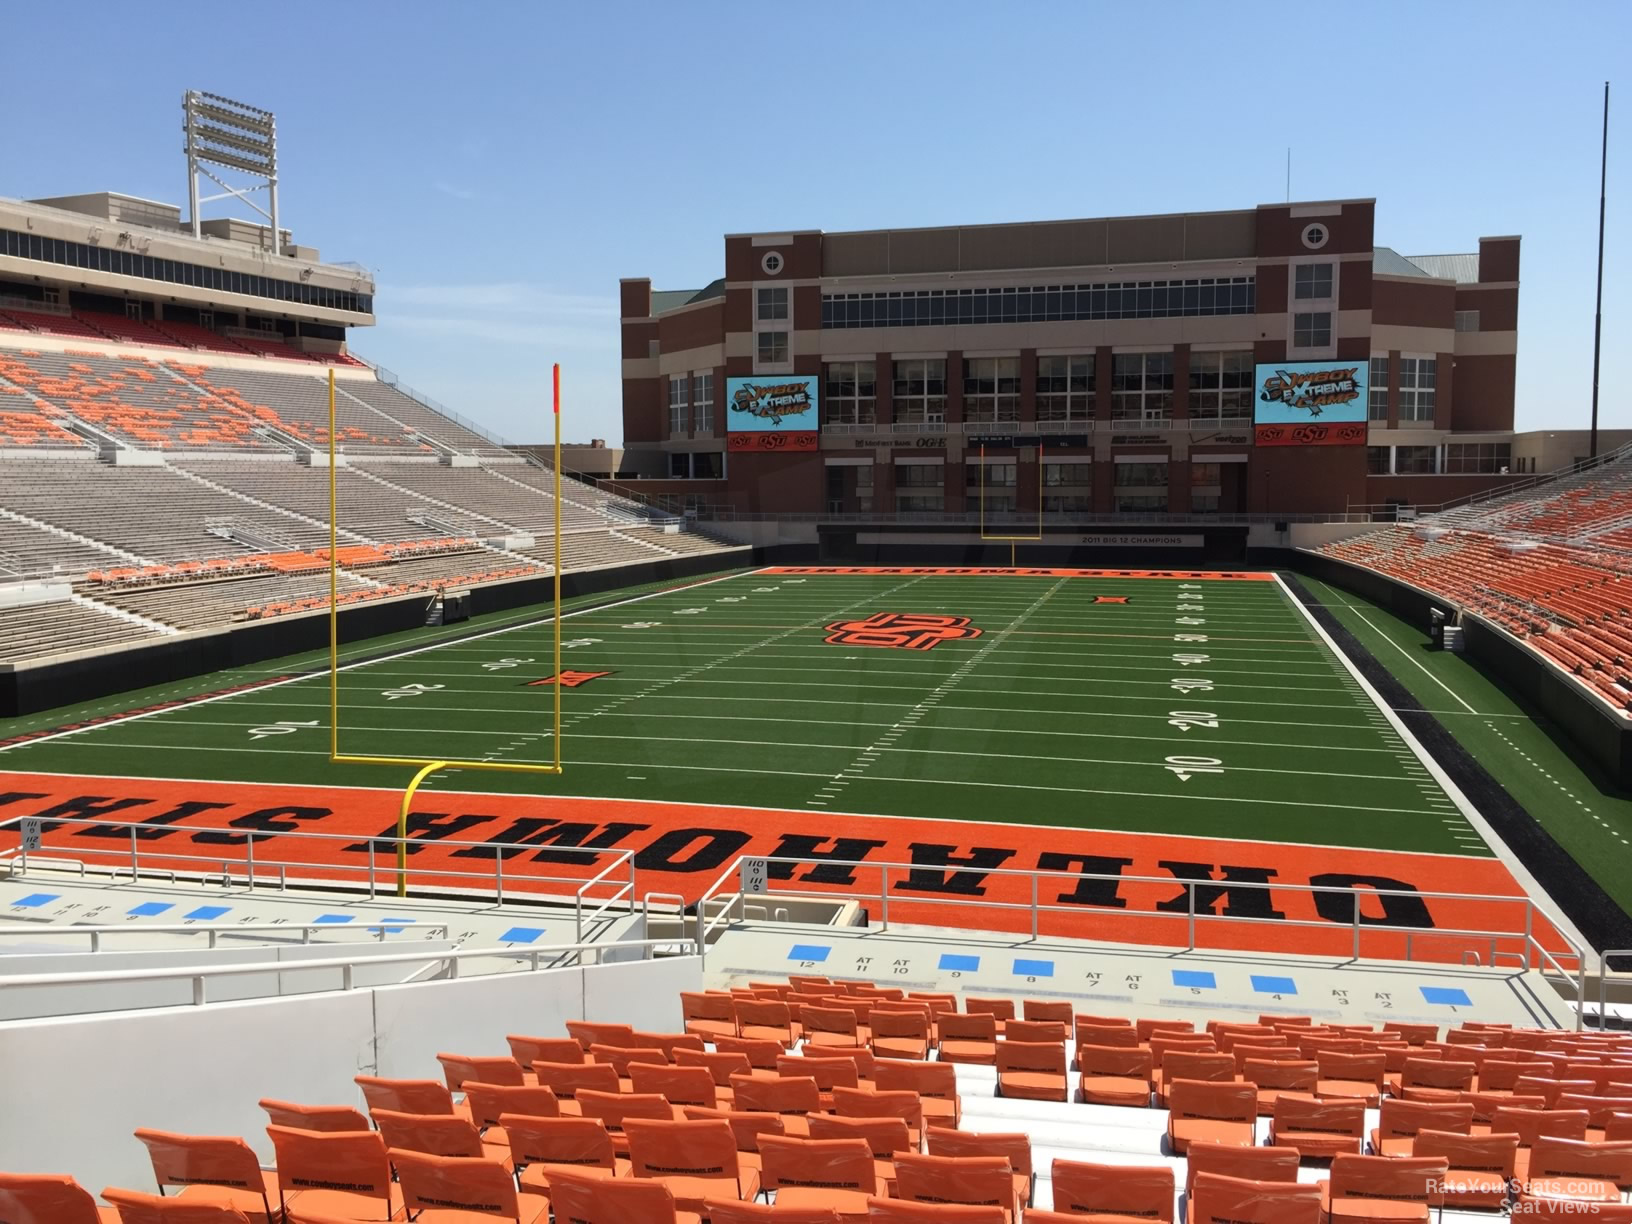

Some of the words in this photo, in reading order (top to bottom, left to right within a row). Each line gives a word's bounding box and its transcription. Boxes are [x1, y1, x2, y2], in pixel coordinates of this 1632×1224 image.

[1264, 367, 1358, 389] COWBOY
[734, 381, 810, 401] COWBOY
[1283, 380, 1353, 401] EXTREME
[749, 393, 806, 411] EXTREME
[1295, 391, 1360, 409] CAMP
[760, 402, 811, 418] CAMP
[758, 432, 788, 449] OSU
[1291, 425, 1329, 443] OSU
[1082, 536, 1100, 544] 2011
[1103, 536, 1118, 544] BIG
[1131, 537, 1182, 545] CHAMPIONS
[381, 683, 446, 697] 20
[1170, 678, 1215, 691] 30
[1167, 711, 1220, 728] 20
[247, 720, 320, 736] 10
[1164, 755, 1225, 774] 10
[750, 877, 763, 885] 111
[856, 956, 874, 964] AT
[1085, 971, 1103, 980] AT
[1125, 974, 1143, 982] AT
[1332, 988, 1349, 997] AT
[1374, 992, 1392, 1000] AT
[1338, 998, 1350, 1006] 3
[1382, 1001, 1393, 1009] 2
[645, 1163, 724, 1175] www.cowboyseats.com
[291, 1177, 375, 1192] www.cowboyseats.com
[777, 1176, 860, 1189] www.cowboyseats.com
[1344, 1189, 1429, 1200] www.cowboyseats.com
